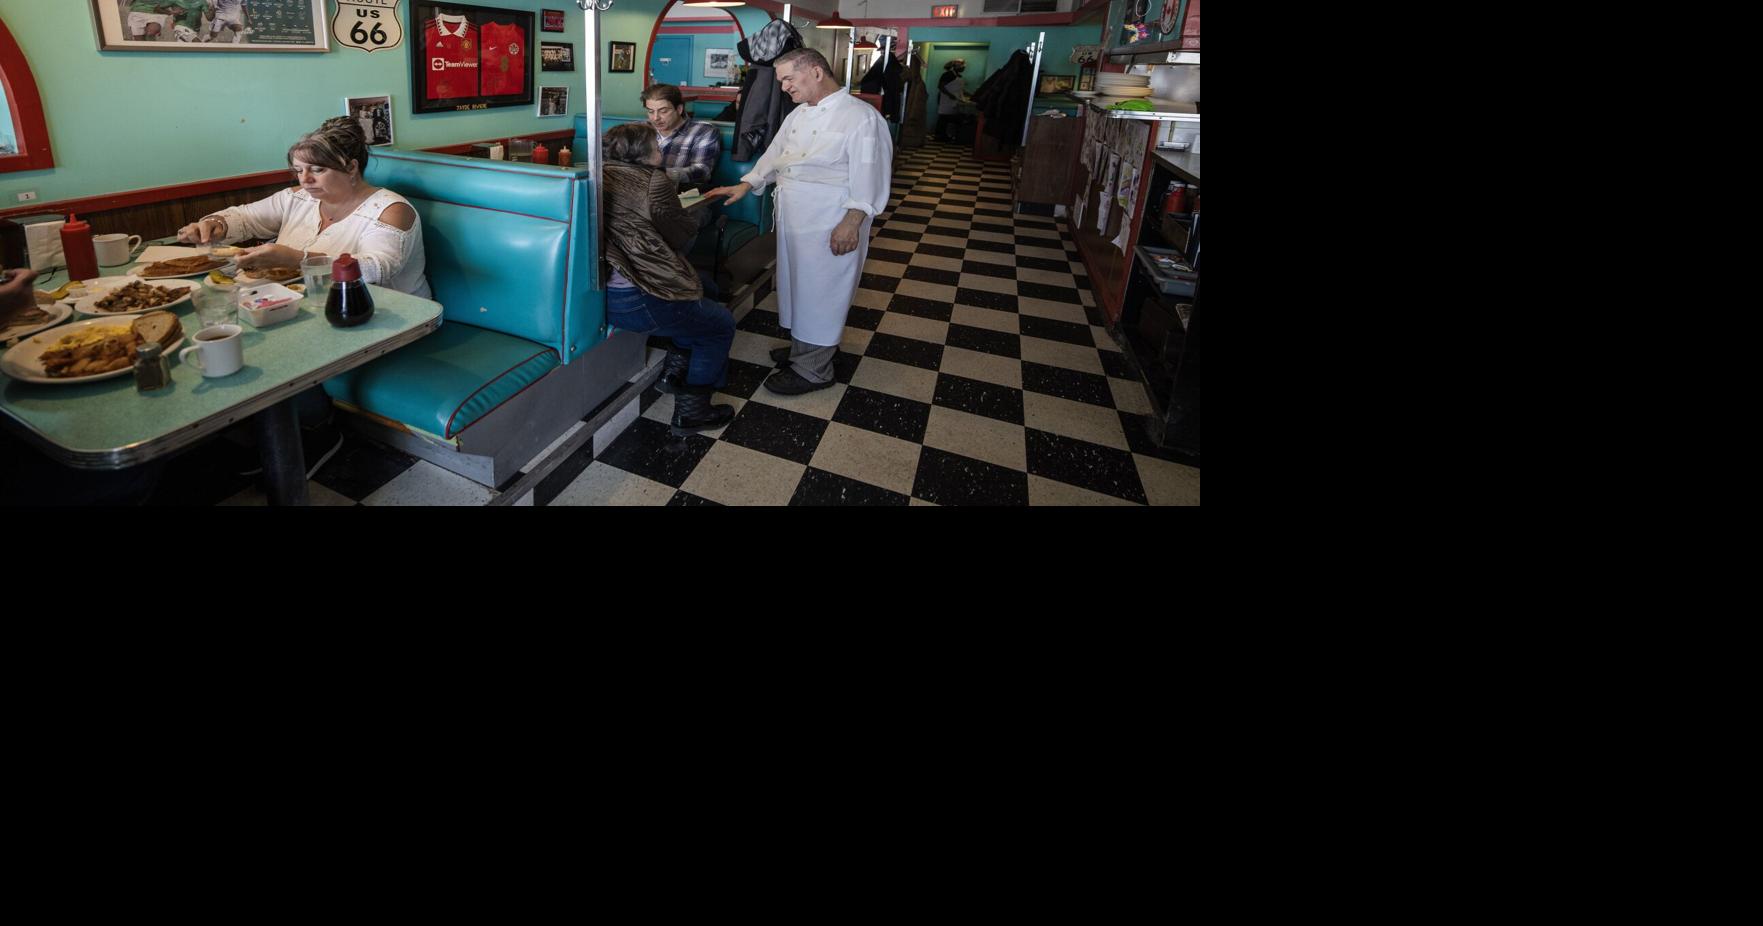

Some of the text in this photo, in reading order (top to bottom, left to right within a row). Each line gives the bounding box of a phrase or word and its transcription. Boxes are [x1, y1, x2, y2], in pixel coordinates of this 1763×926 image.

[356, 9, 380, 19] US
[350, 21, 387, 45] 66
[1078, 55, 1093, 64] 66
